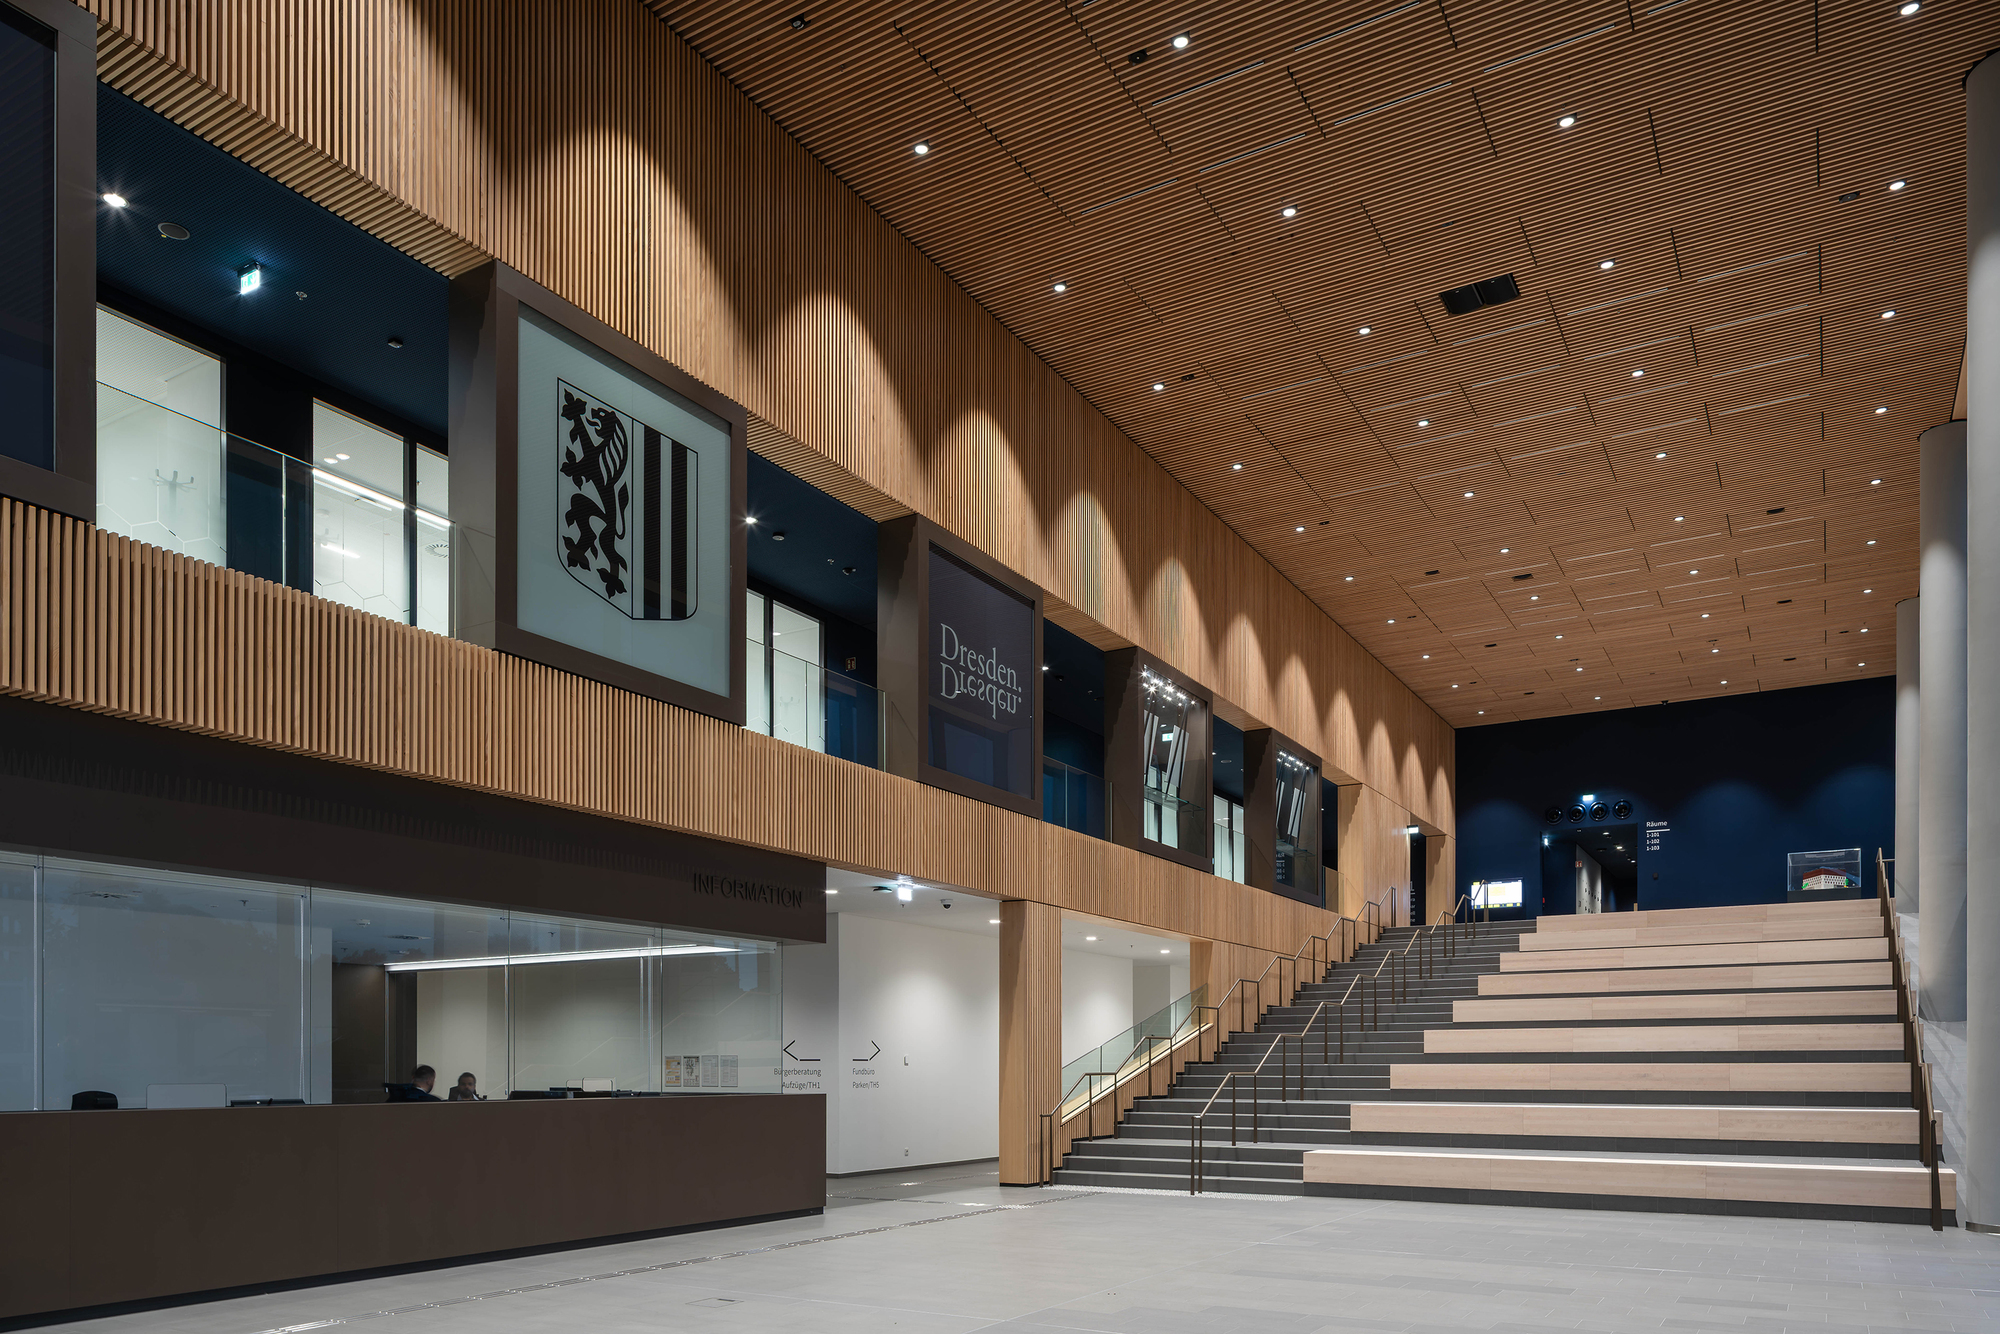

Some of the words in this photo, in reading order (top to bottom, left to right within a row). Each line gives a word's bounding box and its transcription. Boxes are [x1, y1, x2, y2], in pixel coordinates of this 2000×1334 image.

[940, 622, 1022, 693] Dresden.
[693, 872, 802, 909] INFORMATION
[773, 1068, 822, 1077] Bürgerberatung
[852, 1067, 876, 1076] Fundbüro
[782, 1081, 821, 1091] Aufzüge/TH1
